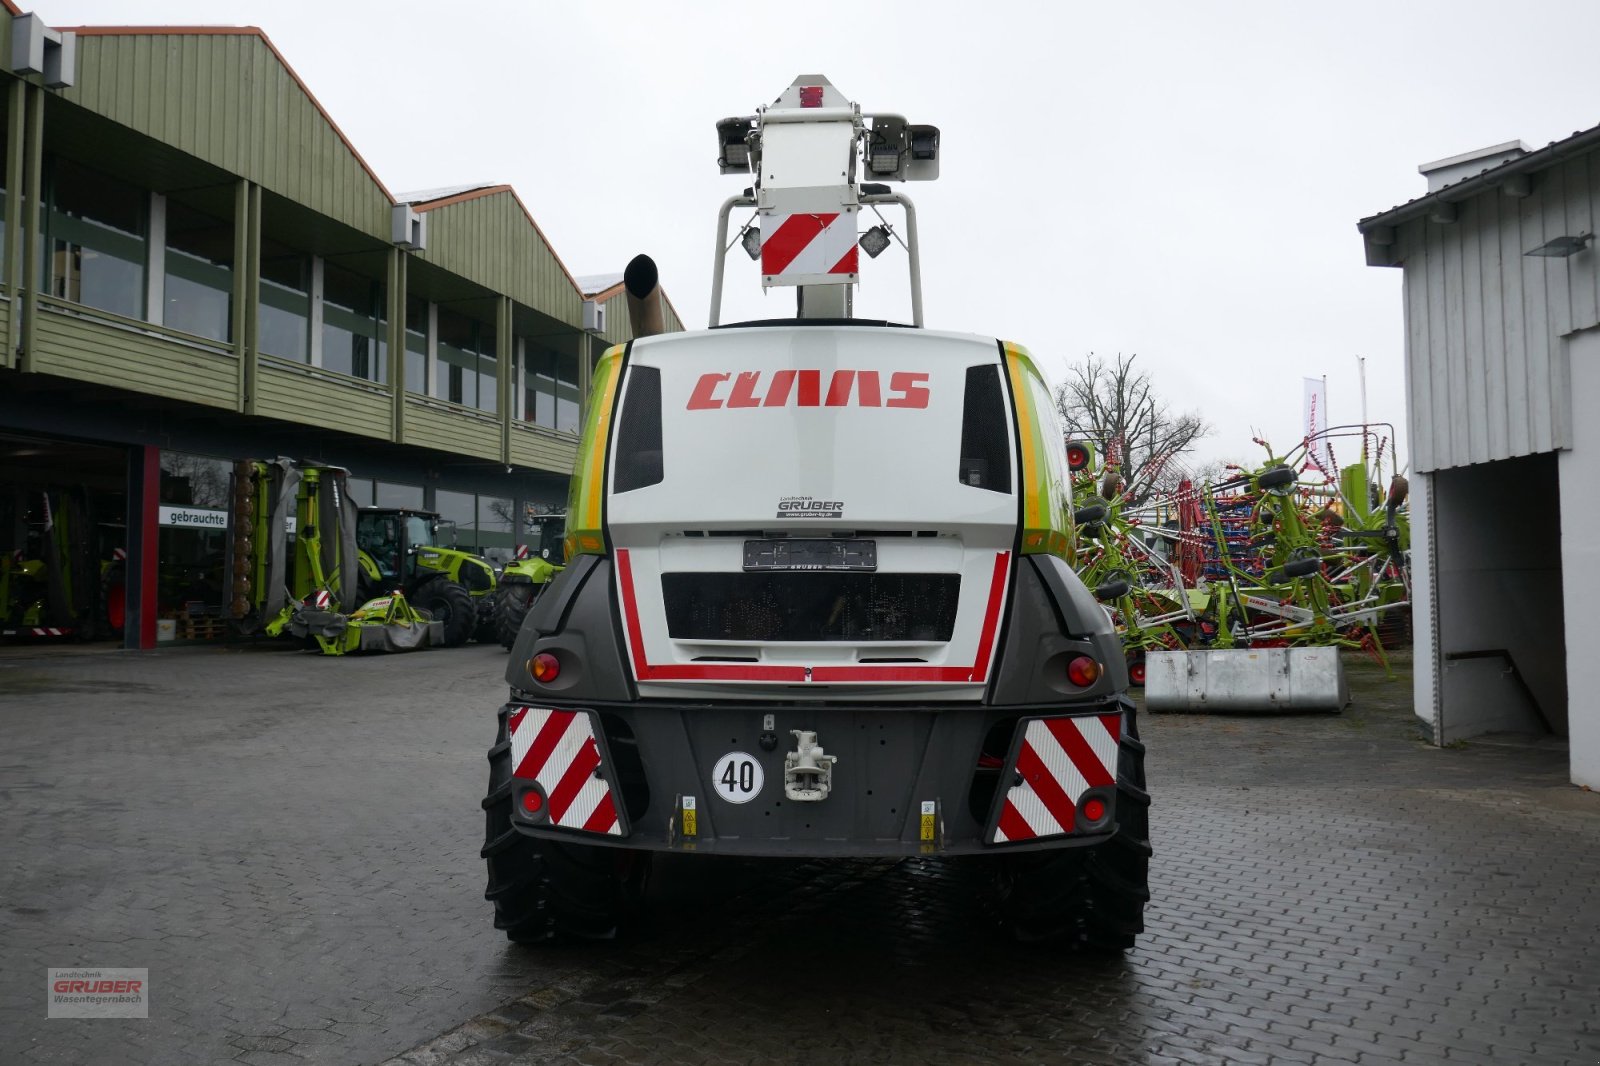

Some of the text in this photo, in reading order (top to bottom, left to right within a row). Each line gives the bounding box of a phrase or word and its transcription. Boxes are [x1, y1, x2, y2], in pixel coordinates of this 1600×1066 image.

[686, 370, 930, 410] CLAAS
[778, 501, 844, 511] GRUBER
[170, 511, 225, 525] gebrauchte
[721, 760, 754, 793] 40
